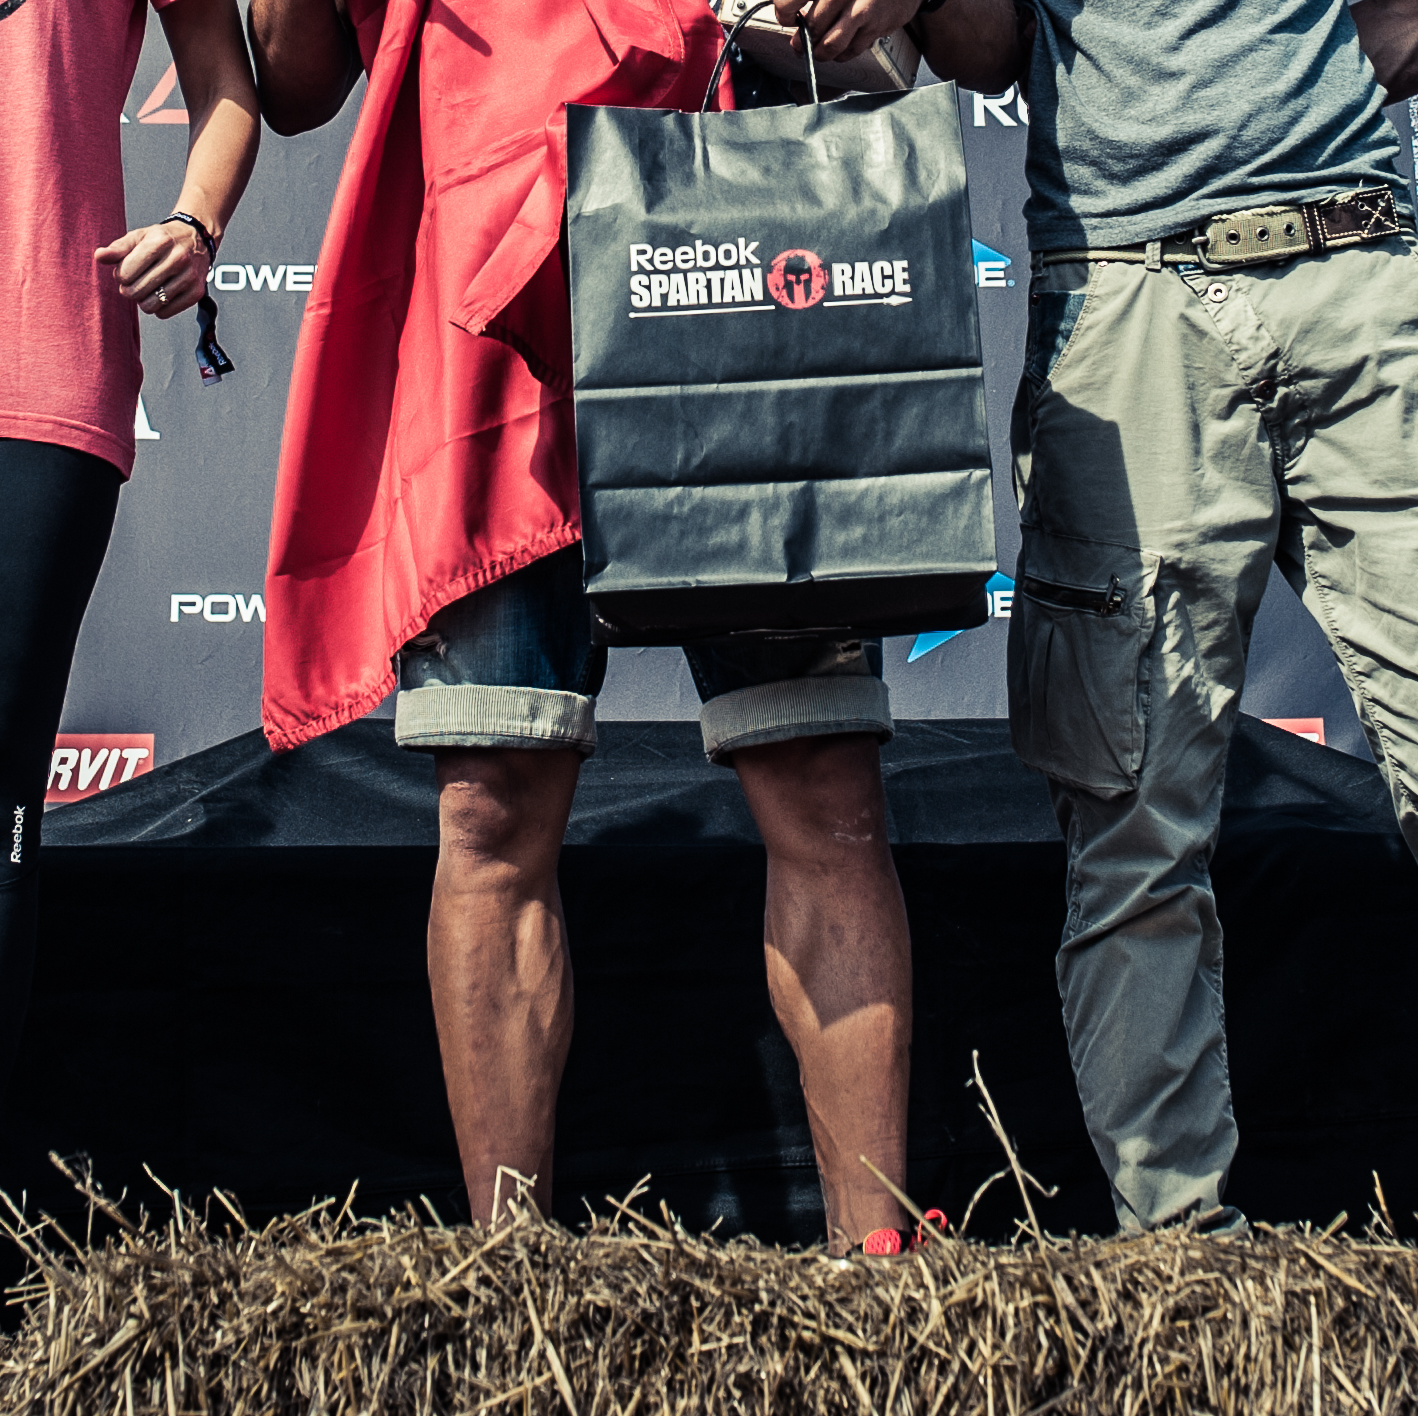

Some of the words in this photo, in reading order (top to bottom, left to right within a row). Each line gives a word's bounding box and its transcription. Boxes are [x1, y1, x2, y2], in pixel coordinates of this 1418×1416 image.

[630, 237, 761, 272] Reebok
[630, 267, 764, 308] SPARTAN
[832, 260, 911, 296] RACE
[10, 805, 26, 863] Reebok
